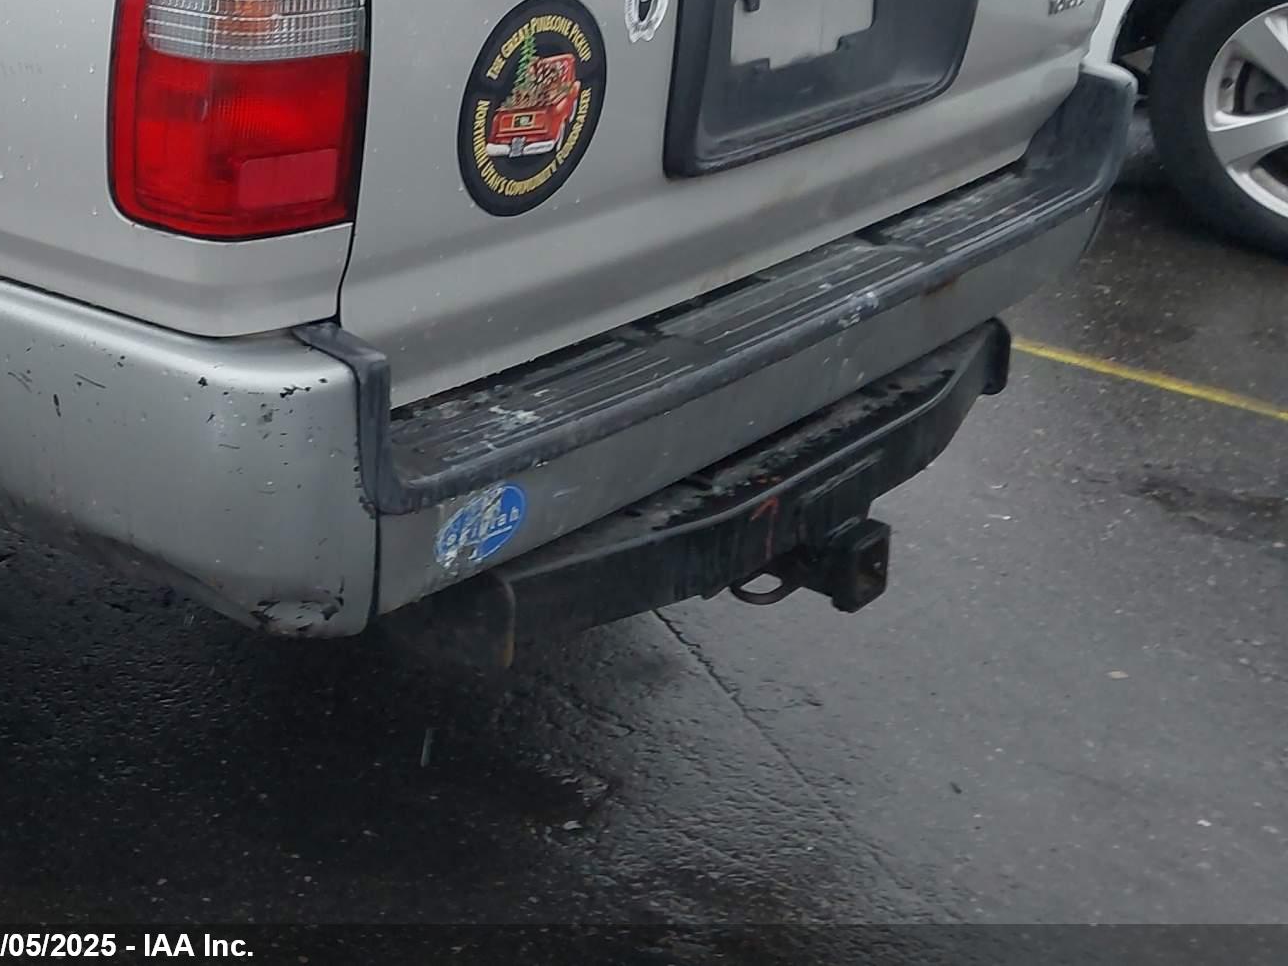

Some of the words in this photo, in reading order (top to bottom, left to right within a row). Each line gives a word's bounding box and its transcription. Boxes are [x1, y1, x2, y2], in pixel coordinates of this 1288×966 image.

[486, 54, 506, 80] THE
[501, 22, 532, 59] GREAT
[530, 15, 574, 37] PINECONE
[568, 22, 592, 62] PICKUP
[473, 100, 490, 169] NORTHERN
[555, 87, 592, 165] FUNDRAISER
[481, 161, 508, 194] UTAH'S
[505, 158, 557, 196] COMMUNITY
